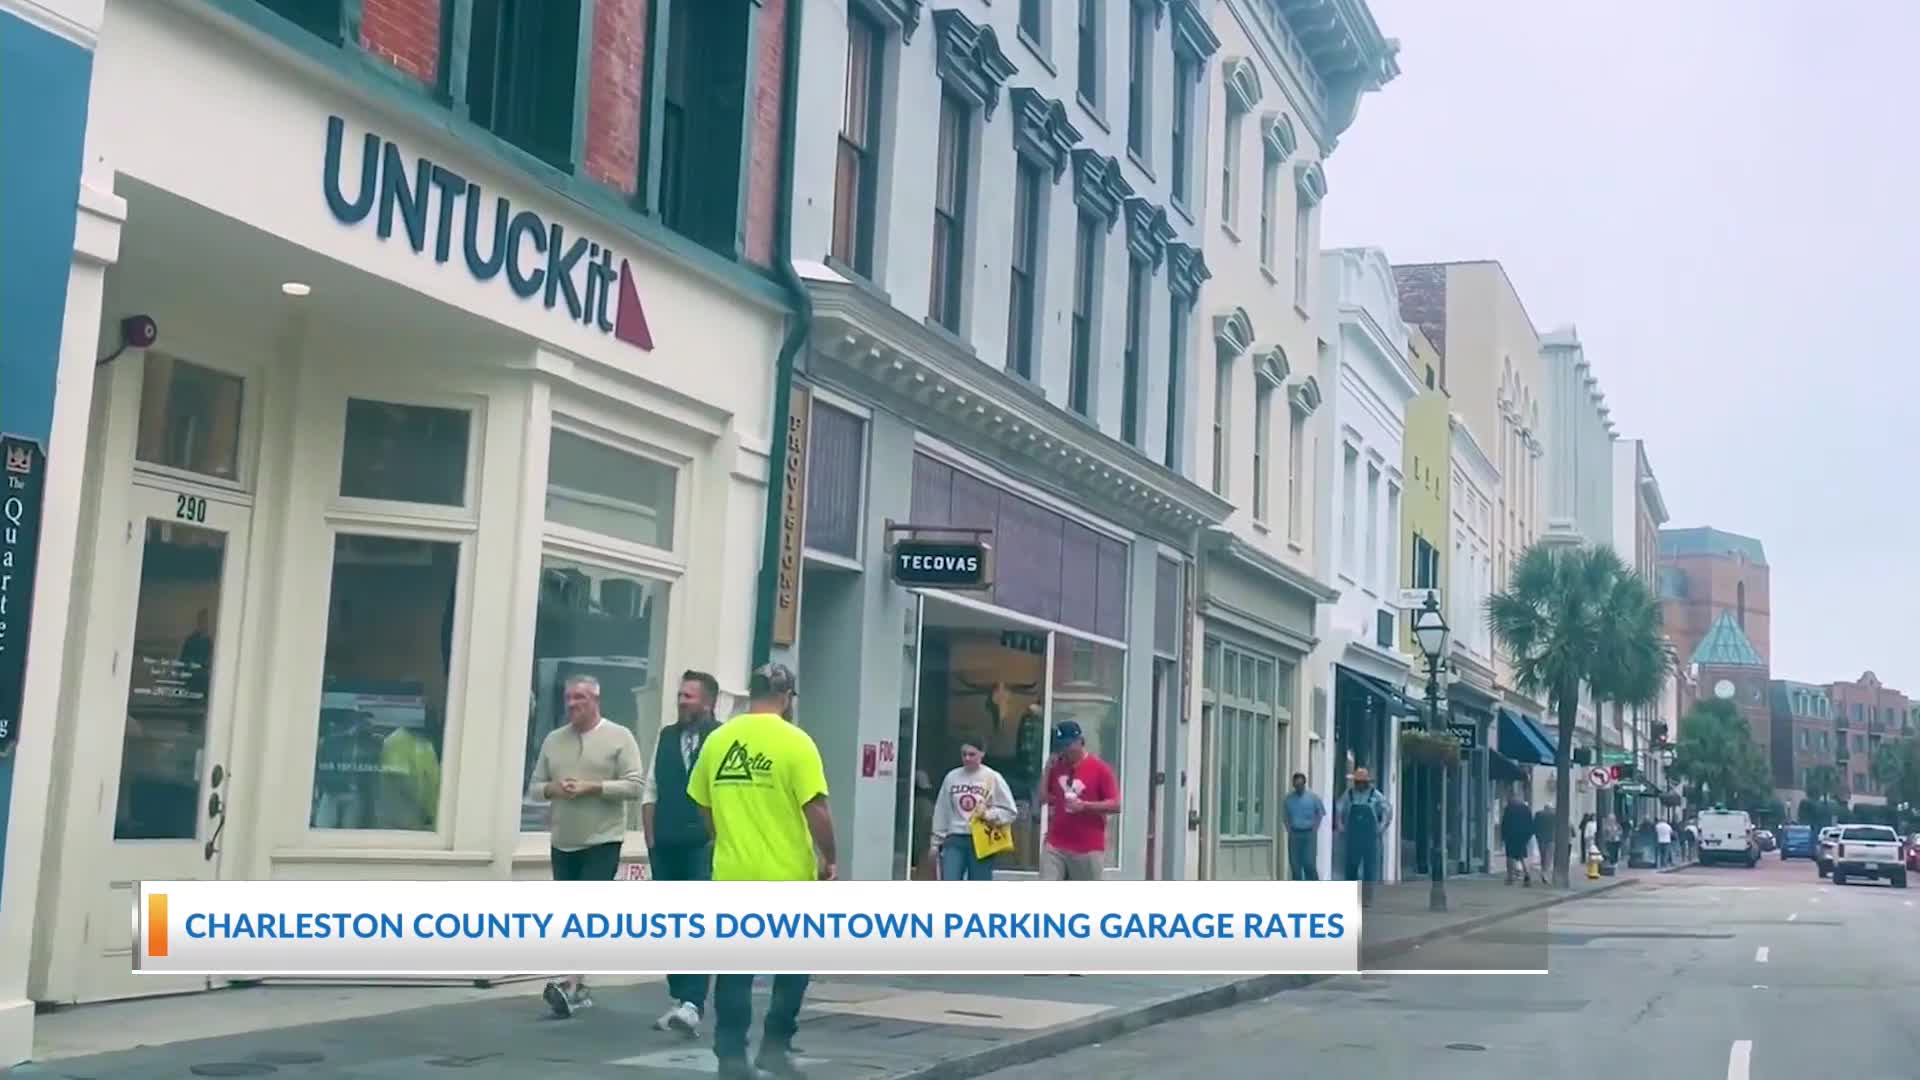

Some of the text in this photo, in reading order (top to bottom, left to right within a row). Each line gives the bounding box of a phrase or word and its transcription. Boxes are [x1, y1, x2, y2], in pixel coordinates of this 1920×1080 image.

[323, 115, 618, 333] UNTUCKit
[8, 476, 25, 489] The
[176, 494, 207, 522] 290
[901, 554, 978, 571] TECOVAS
[725, 743, 773, 771] Delta
